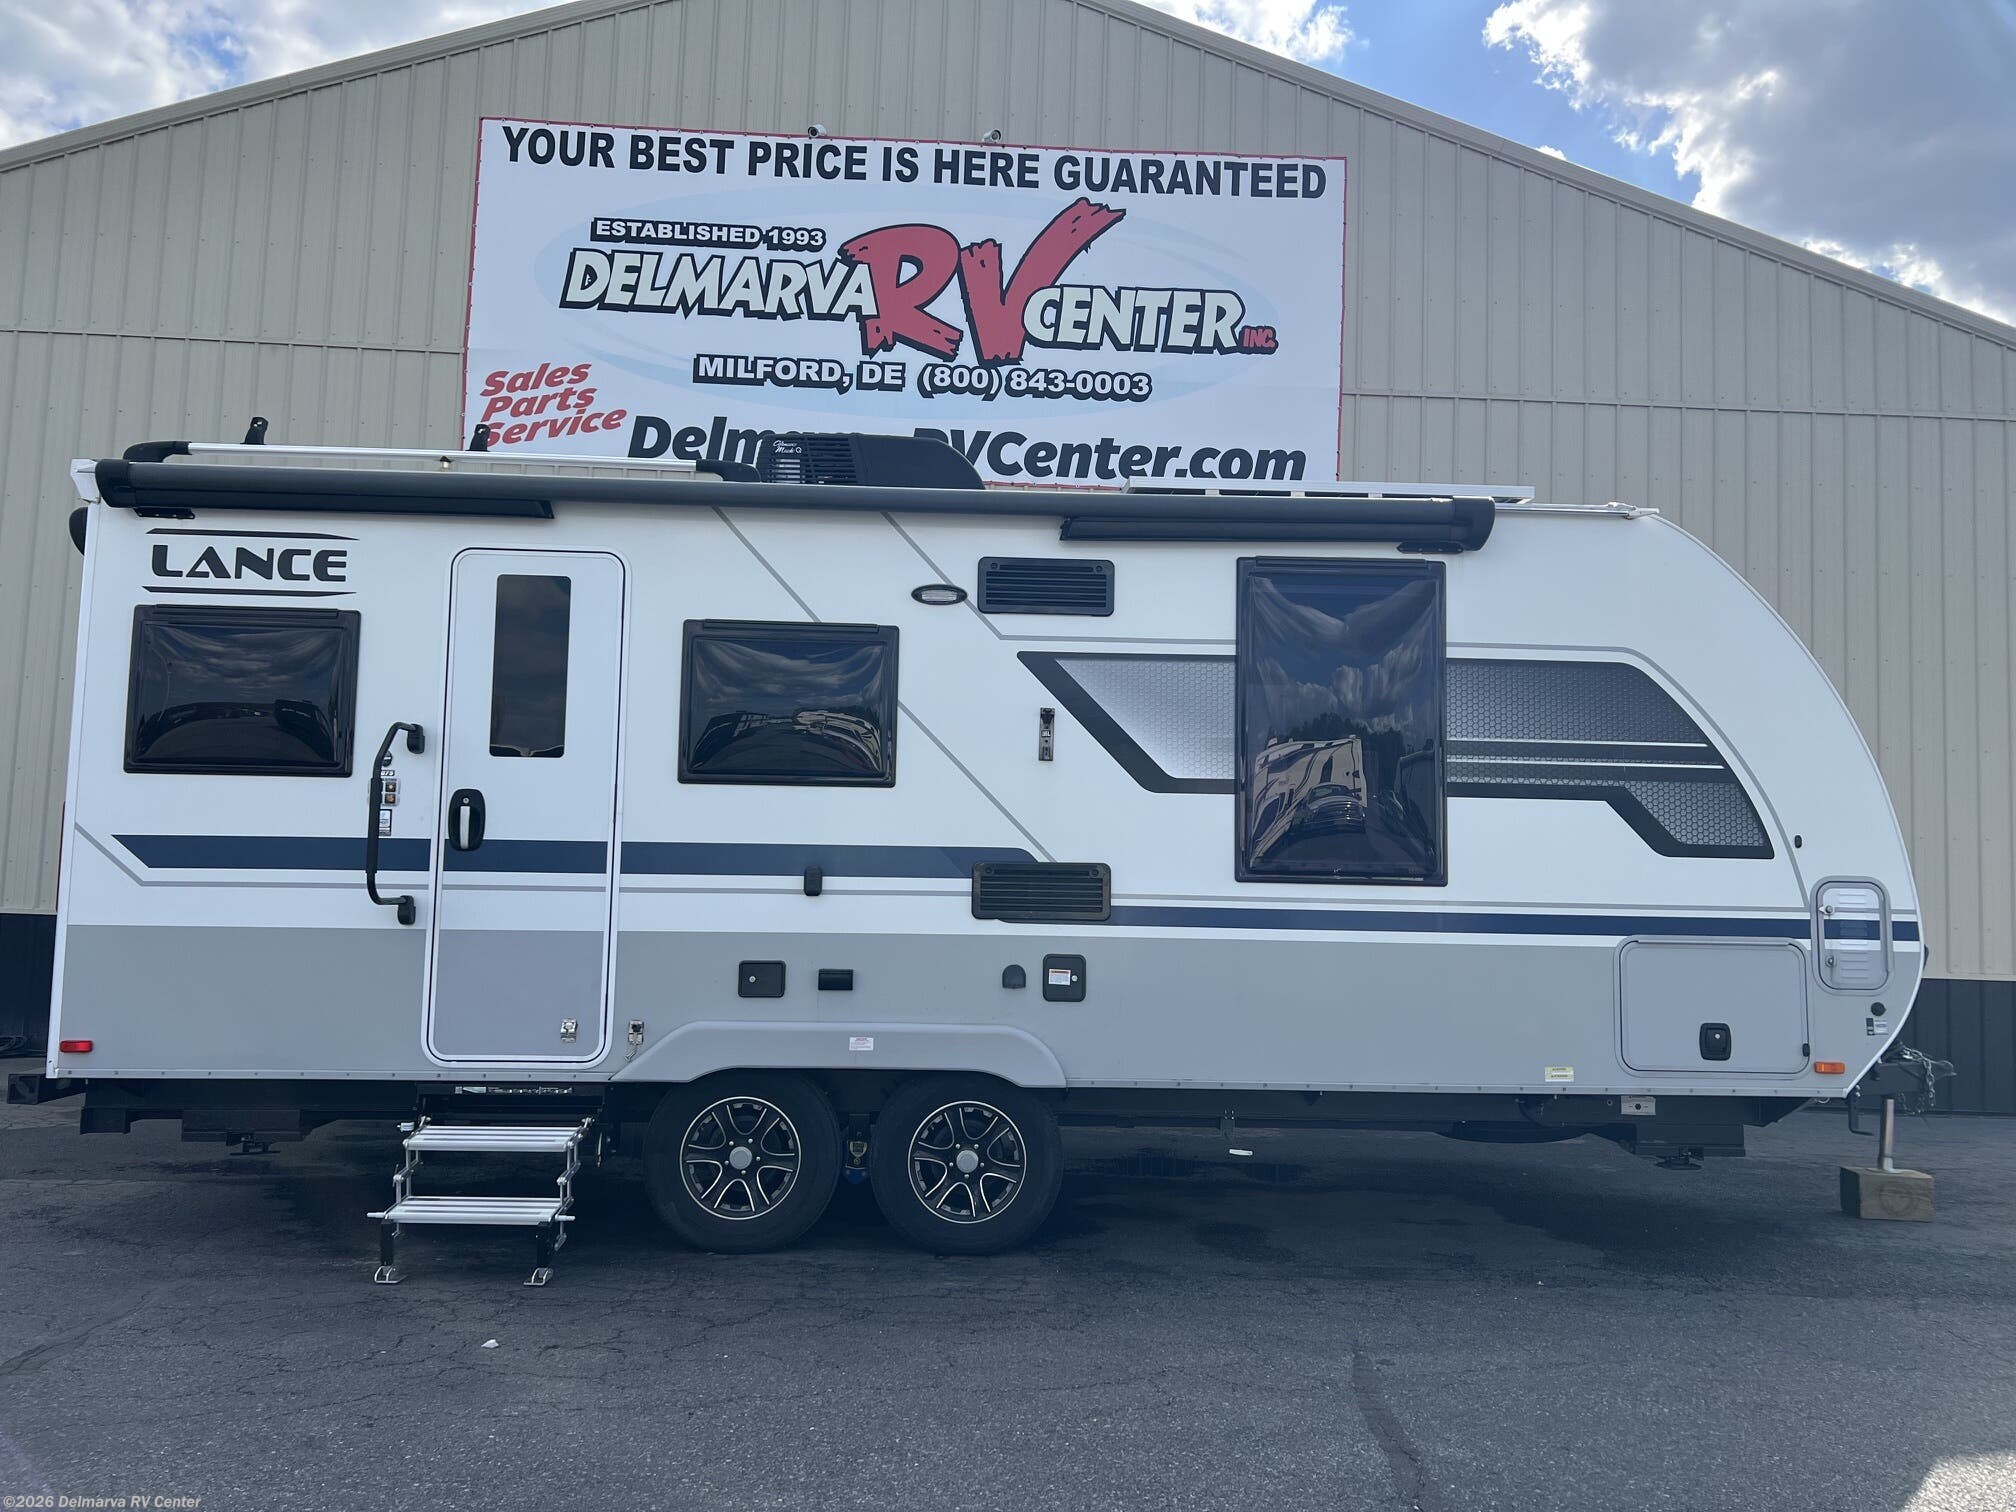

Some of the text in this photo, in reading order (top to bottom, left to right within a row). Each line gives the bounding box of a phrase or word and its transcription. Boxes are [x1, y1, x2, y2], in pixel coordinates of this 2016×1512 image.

[502, 126, 1327, 199] YOUR BEST PRICE IS HERE GUARANTEED
[594, 219, 825, 248] ESTABLISHED 1993
[561, 249, 878, 319] DELMARVA
[840, 197, 1126, 365] RV
[1023, 286, 1244, 351] CENTER
[480, 363, 592, 397] Sales
[696, 354, 1151, 398] MILFORD, DE (800) 843-0003
[480, 387, 598, 422] Parts
[487, 409, 627, 447] Service
[152, 544, 348, 583] LANCE
